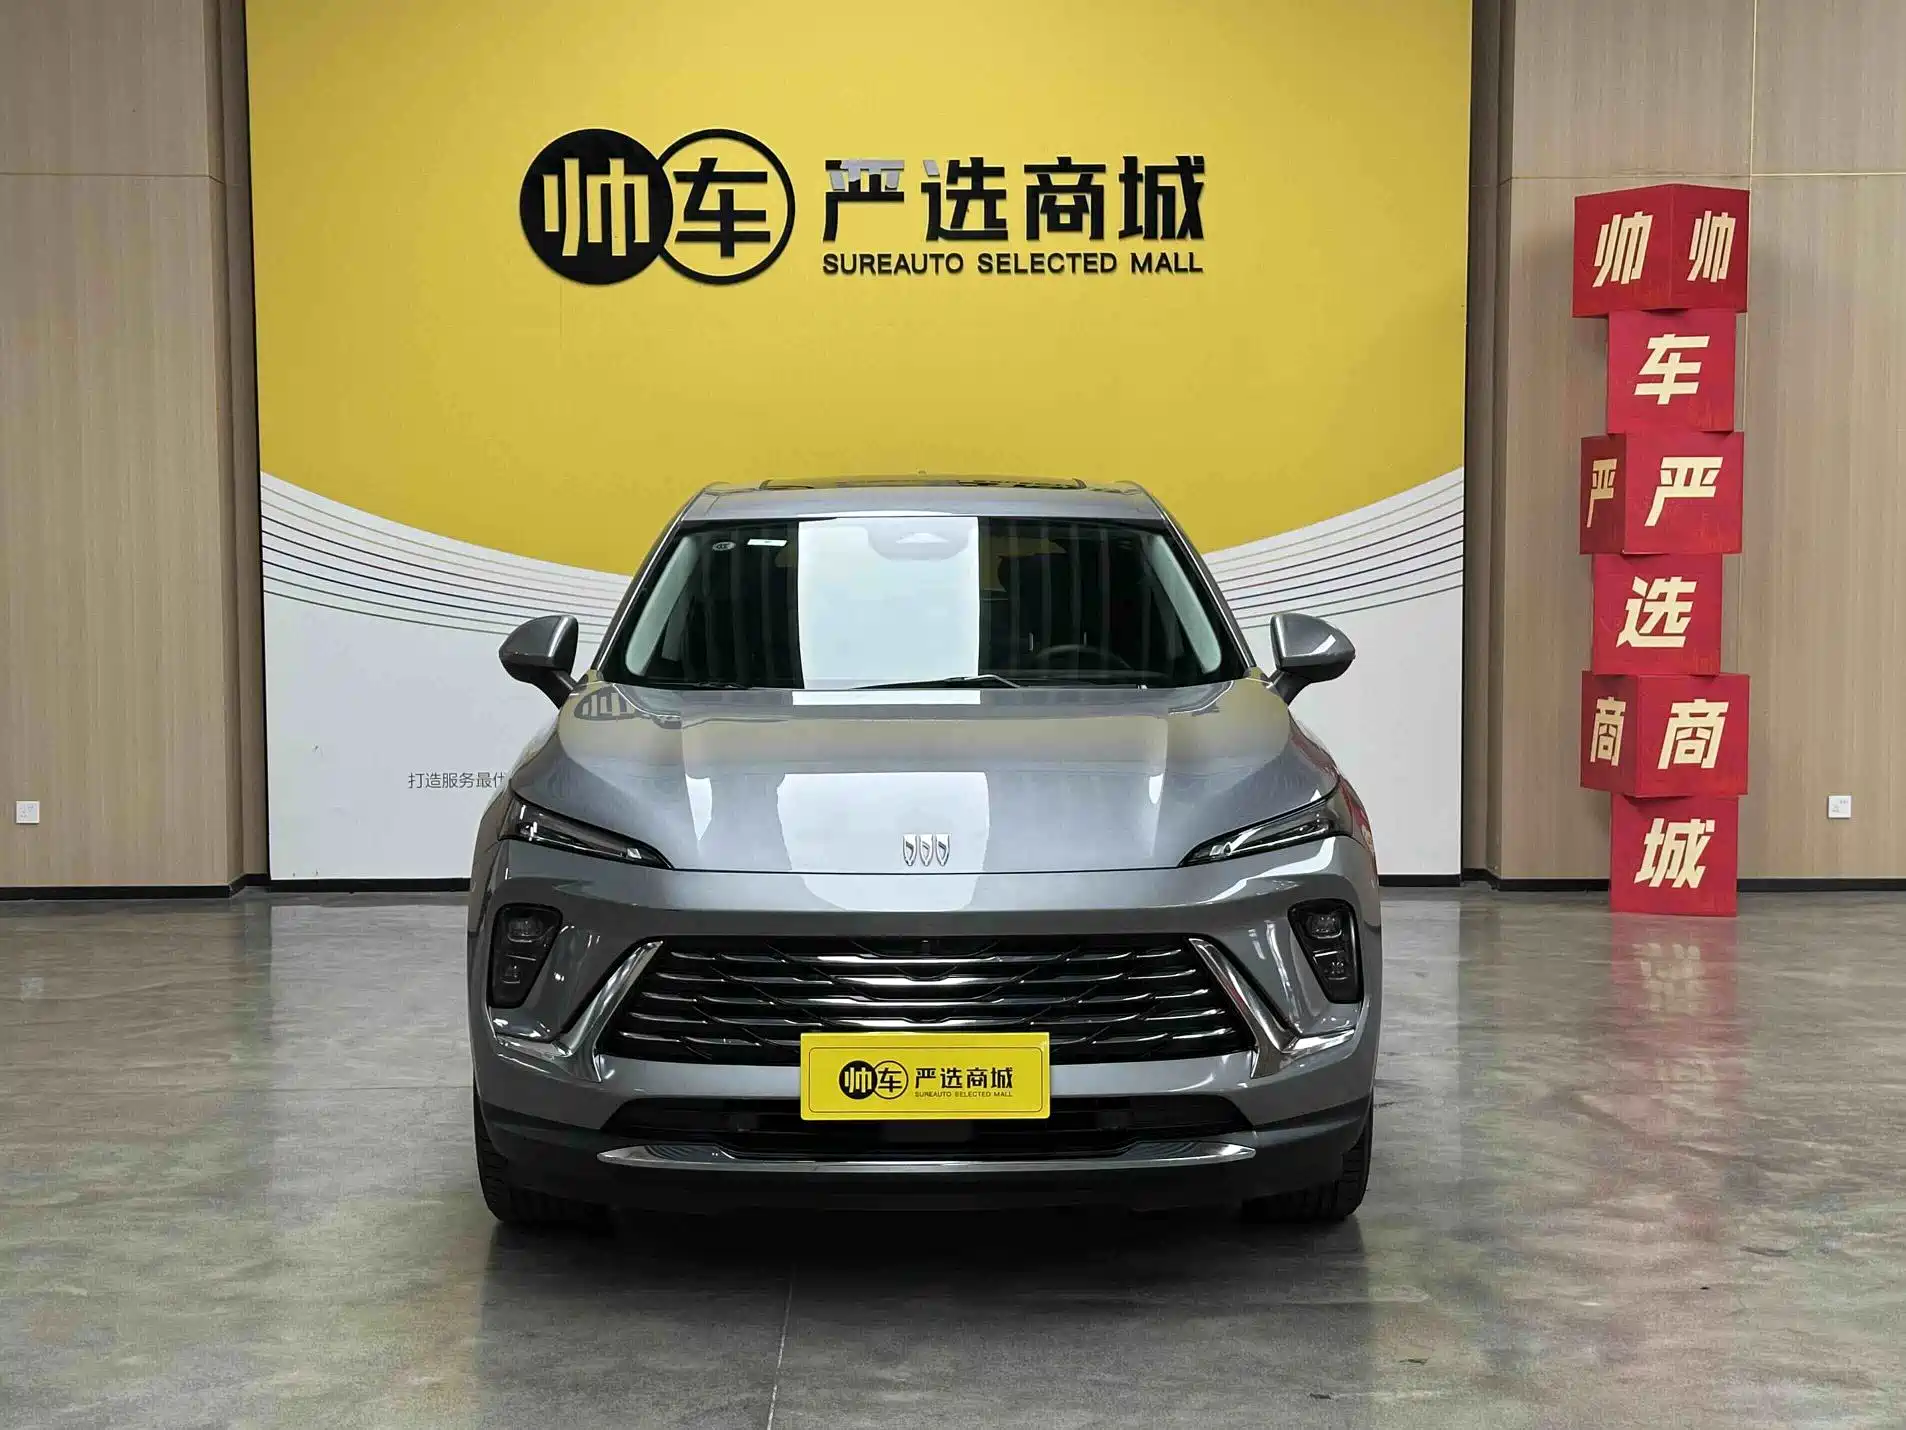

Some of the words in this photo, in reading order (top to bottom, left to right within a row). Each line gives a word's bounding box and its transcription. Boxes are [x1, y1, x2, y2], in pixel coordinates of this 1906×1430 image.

[543, 156, 772, 258] 帅车
[822, 155, 1206, 242] 严选商城
[822, 252, 964, 275] SUREAUTO
[978, 252, 1118, 274] SELECTED
[1131, 251, 1204, 273] MALL
[1592, 211, 1653, 287] 帅
[1687, 210, 1736, 282] 帅
[1633, 333, 1710, 405] 车
[1586, 458, 1618, 528] 严
[1643, 456, 1723, 527] 严
[1615, 576, 1697, 648] 选
[1590, 696, 1626, 767] 商
[1656, 698, 1729, 770] 商
[1633, 817, 1715, 889] 城
[844, 1067, 902, 1093] 帅车
[914, 1067, 1013, 1089] 严选商城
